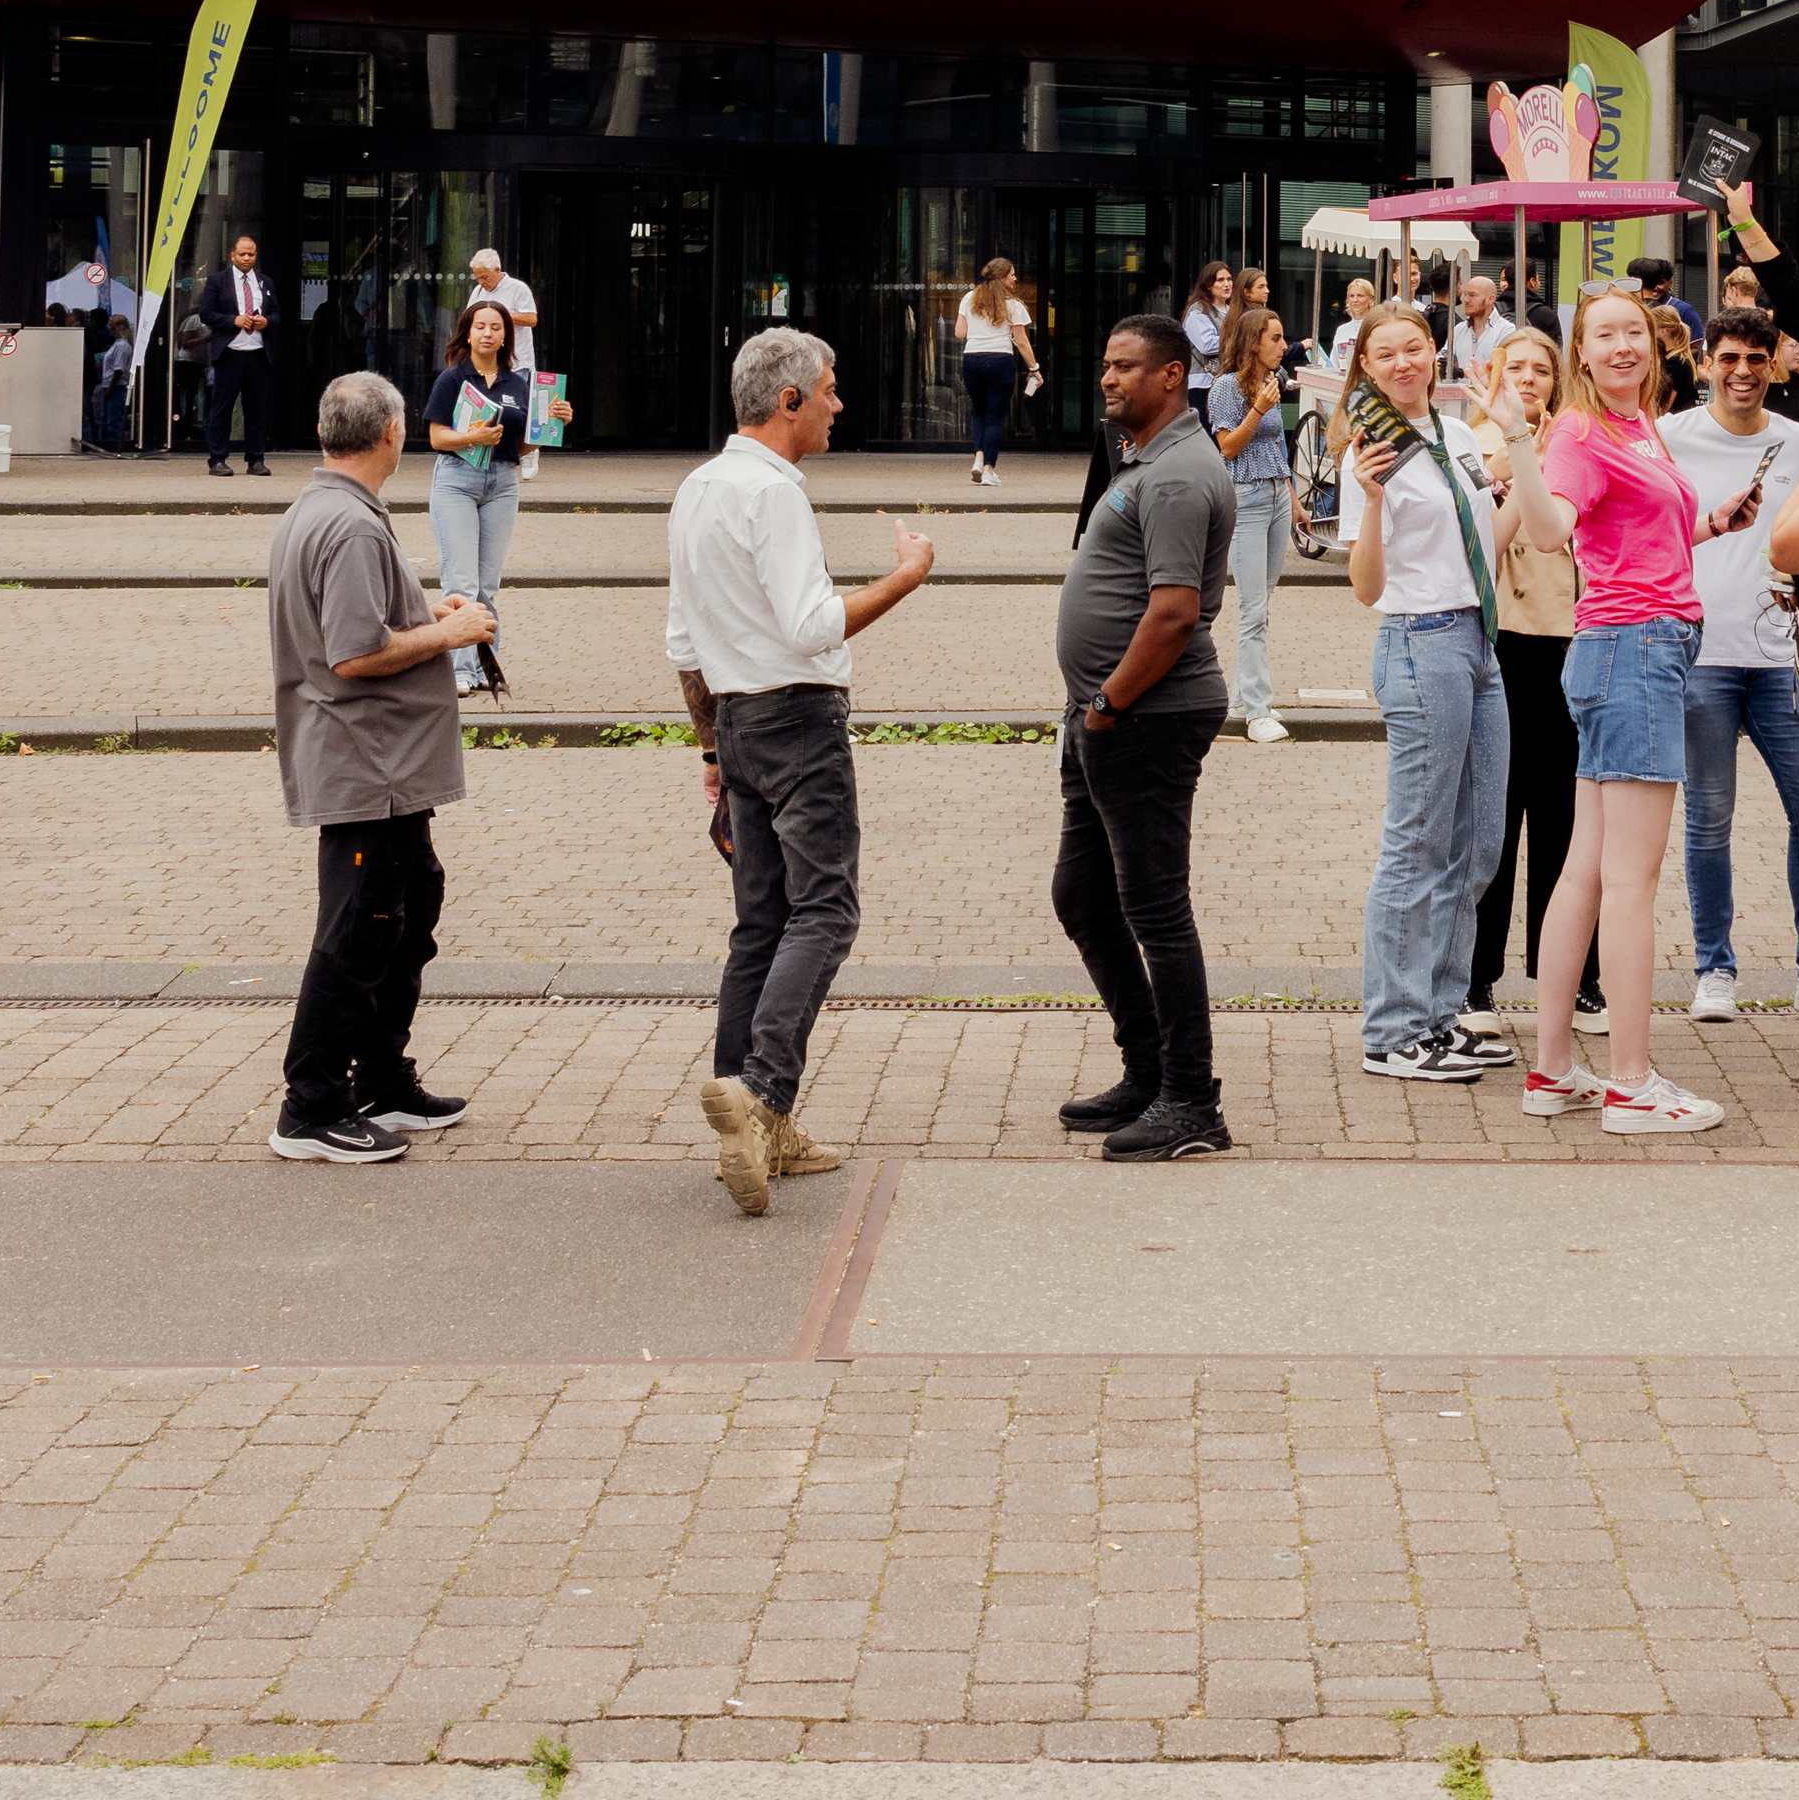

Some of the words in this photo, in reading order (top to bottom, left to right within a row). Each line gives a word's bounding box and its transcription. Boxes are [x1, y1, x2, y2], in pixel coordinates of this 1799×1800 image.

[1519, 93, 1565, 141] MORELLI
[1710, 146, 1736, 163] INTAC
[1592, 85, 1623, 277] WEKOM
